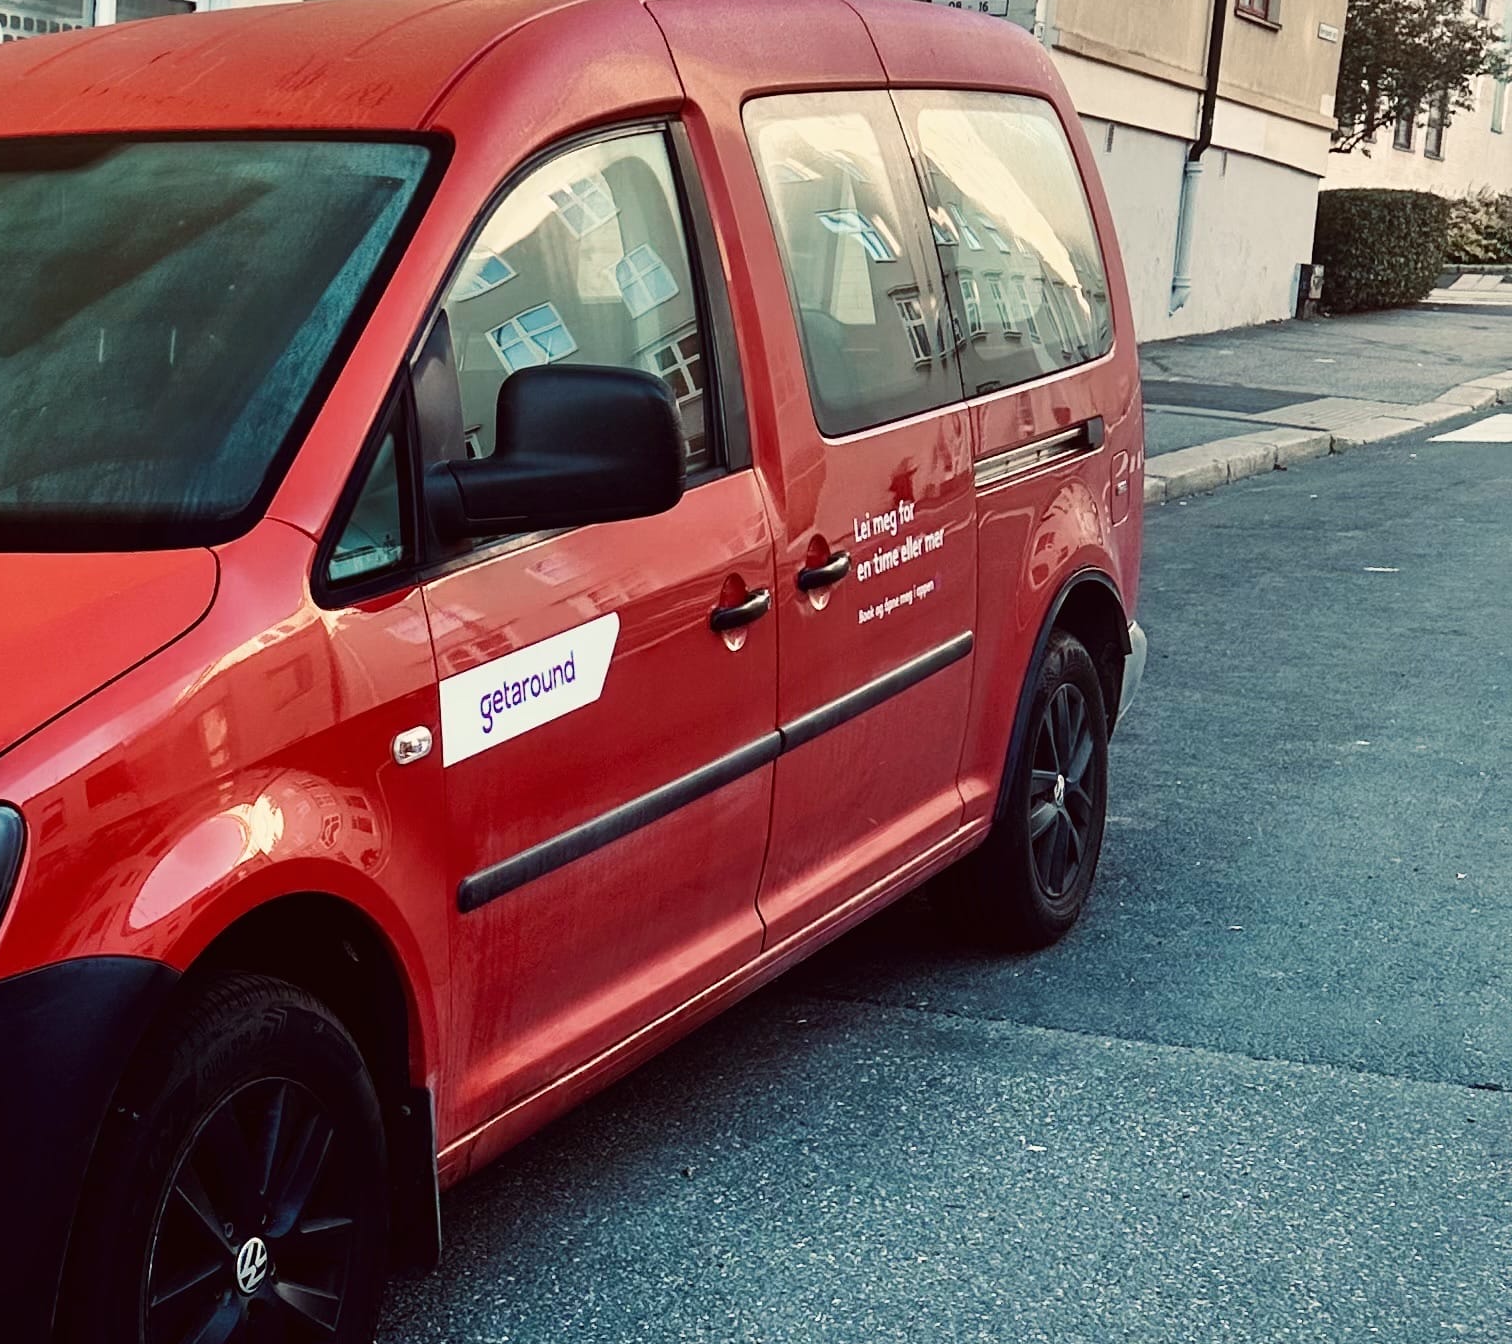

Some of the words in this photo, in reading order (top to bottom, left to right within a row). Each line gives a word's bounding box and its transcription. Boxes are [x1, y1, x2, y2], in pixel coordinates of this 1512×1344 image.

[853, 512, 871, 543] Lei
[873, 510, 897, 536] meg
[898, 499, 915, 525] for
[856, 560, 872, 582] en
[873, 547, 900, 574] time
[900, 535, 923, 562] eller
[924, 528, 945, 553] mer
[480, 649, 576, 734] getaround
